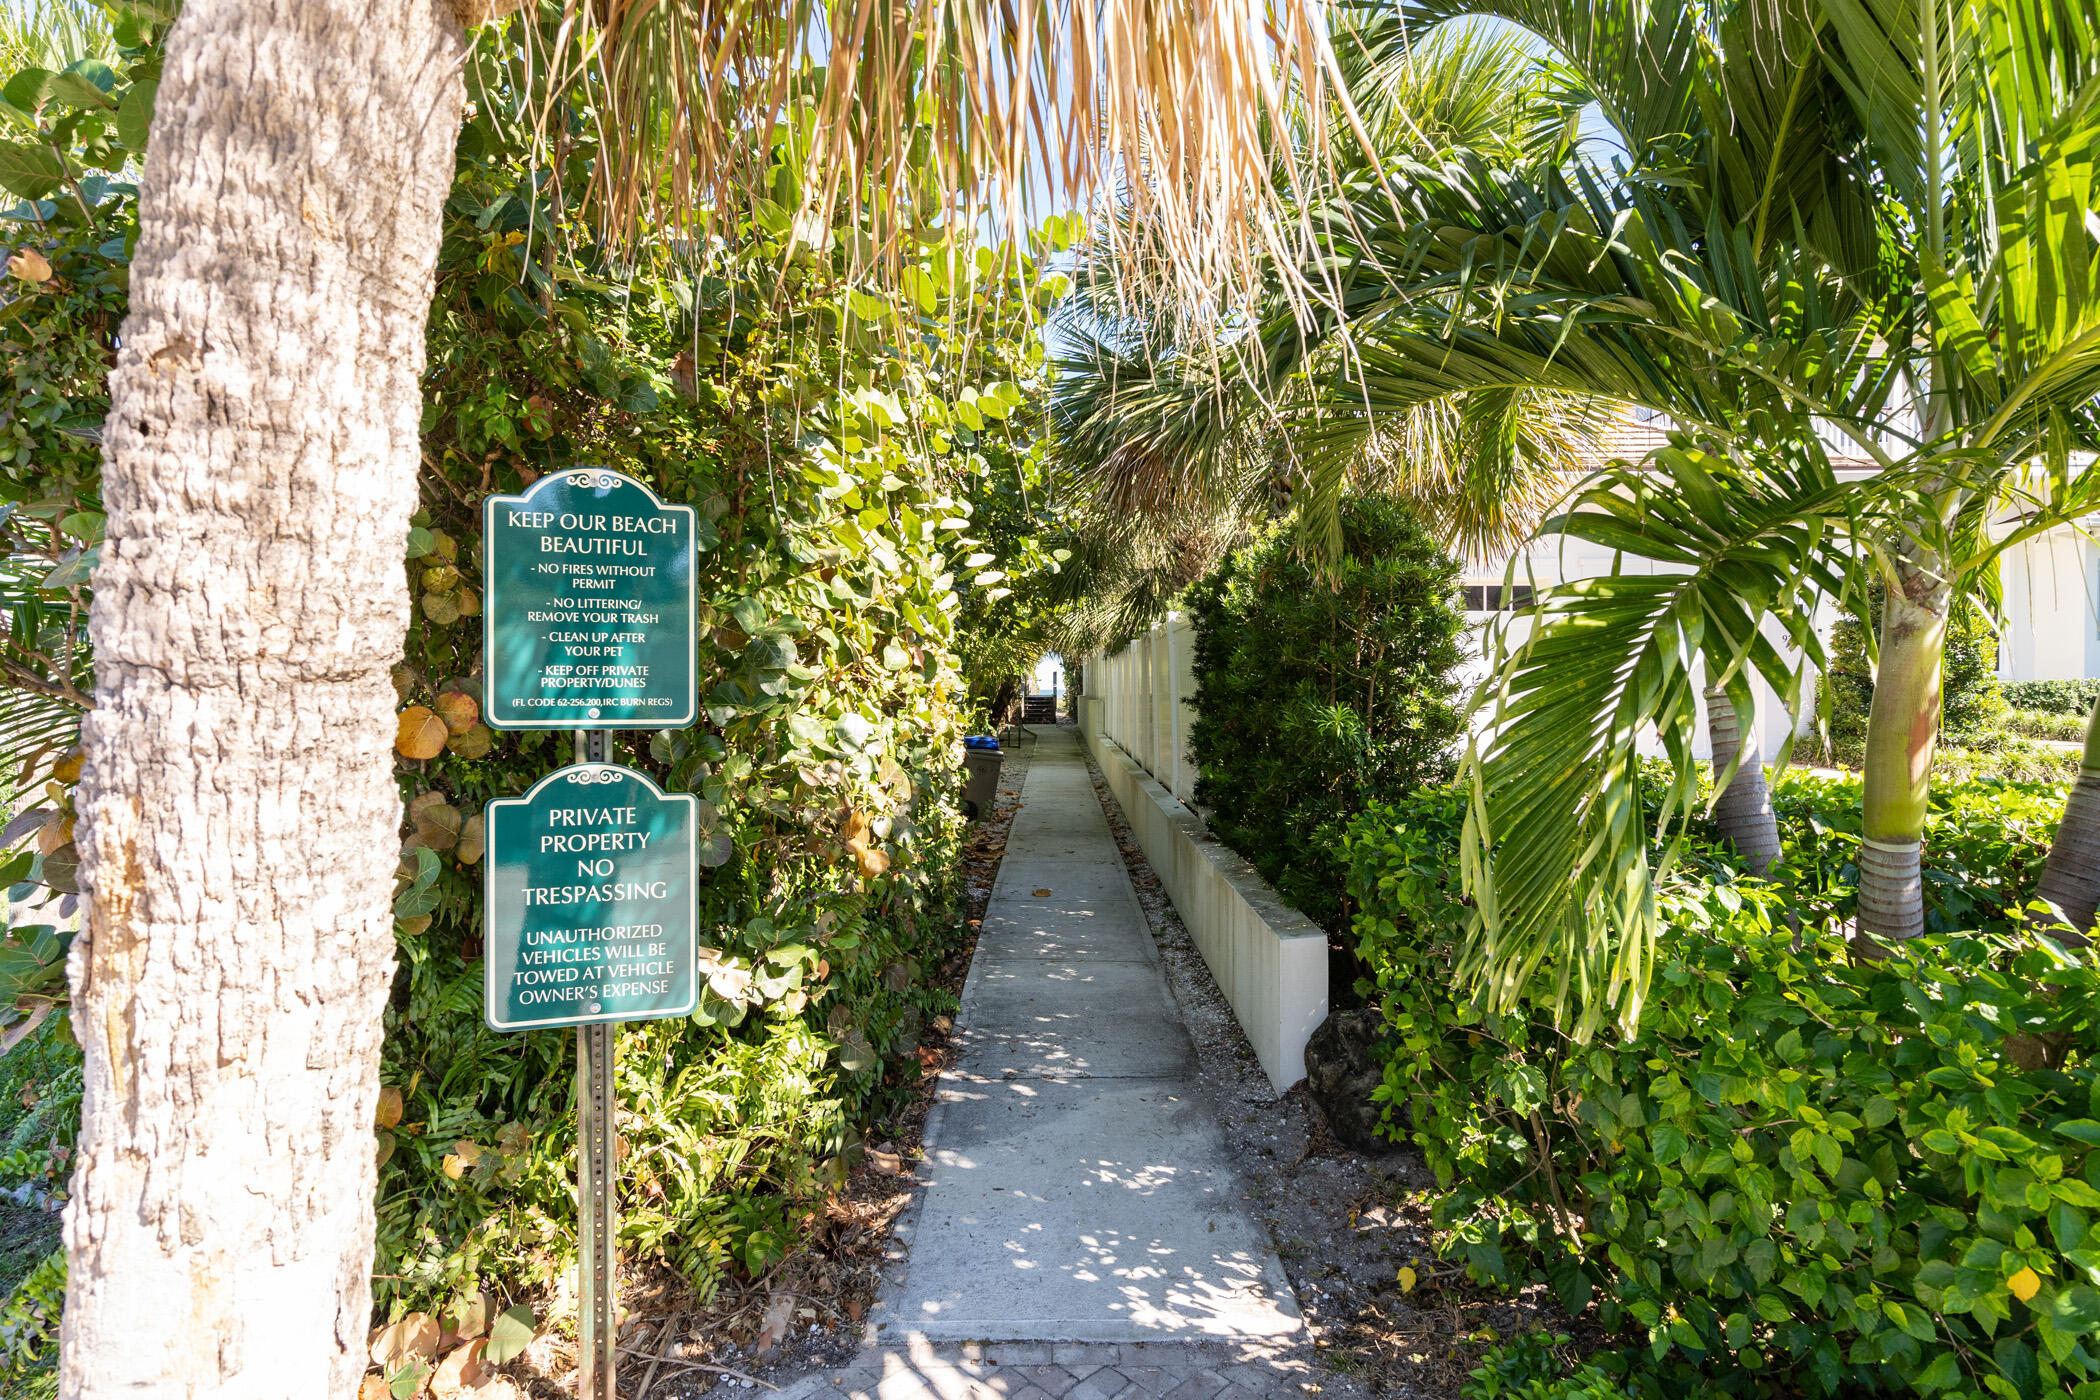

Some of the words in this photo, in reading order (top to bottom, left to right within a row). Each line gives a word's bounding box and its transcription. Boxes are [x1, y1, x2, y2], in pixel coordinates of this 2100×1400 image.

[508, 511, 554, 528] KEEP
[560, 513, 606, 531] OUR
[612, 517, 676, 534] BEACH
[541, 536, 647, 556] BEAUTIFUL
[538, 564, 560, 574] NO
[563, 564, 593, 575] FIRES
[595, 565, 655, 576] WITHOUT
[572, 579, 615, 589] PERMIT
[554, 598, 574, 608] NO
[528, 612, 579, 622] REMOVE
[582, 612, 617, 623] YOUR
[620, 613, 658, 624] TRASH
[549, 632, 588, 642] CLEAN
[592, 633, 608, 642] UP
[610, 633, 645, 643] AFTER
[564, 646, 600, 656] YOUR
[603, 647, 623, 656] PET
[545, 666, 572, 676] KEEP
[576, 666, 599, 676] OFF
[602, 666, 648, 676] PRIVATE
[513, 698, 526, 707] (FL
[620, 698, 646, 706] BURN
[648, 698, 673, 706] REGS)
[549, 807, 636, 827] PRIVATE
[541, 832, 650, 853] PROPERTY
[578, 859, 614, 877] NO
[521, 882, 667, 906] TRESPASSING
[527, 924, 662, 946] UNAUTHORIZED
[522, 947, 601, 965] VEHICLES
[605, 945, 646, 959] WILL
[649, 943, 666, 956] BE
[514, 968, 578, 986] TOWED
[583, 966, 604, 980] AT
[608, 961, 674, 978] VEHICLE
[519, 985, 597, 1004] OWNER’S
[603, 980, 668, 998] EXPENSE
